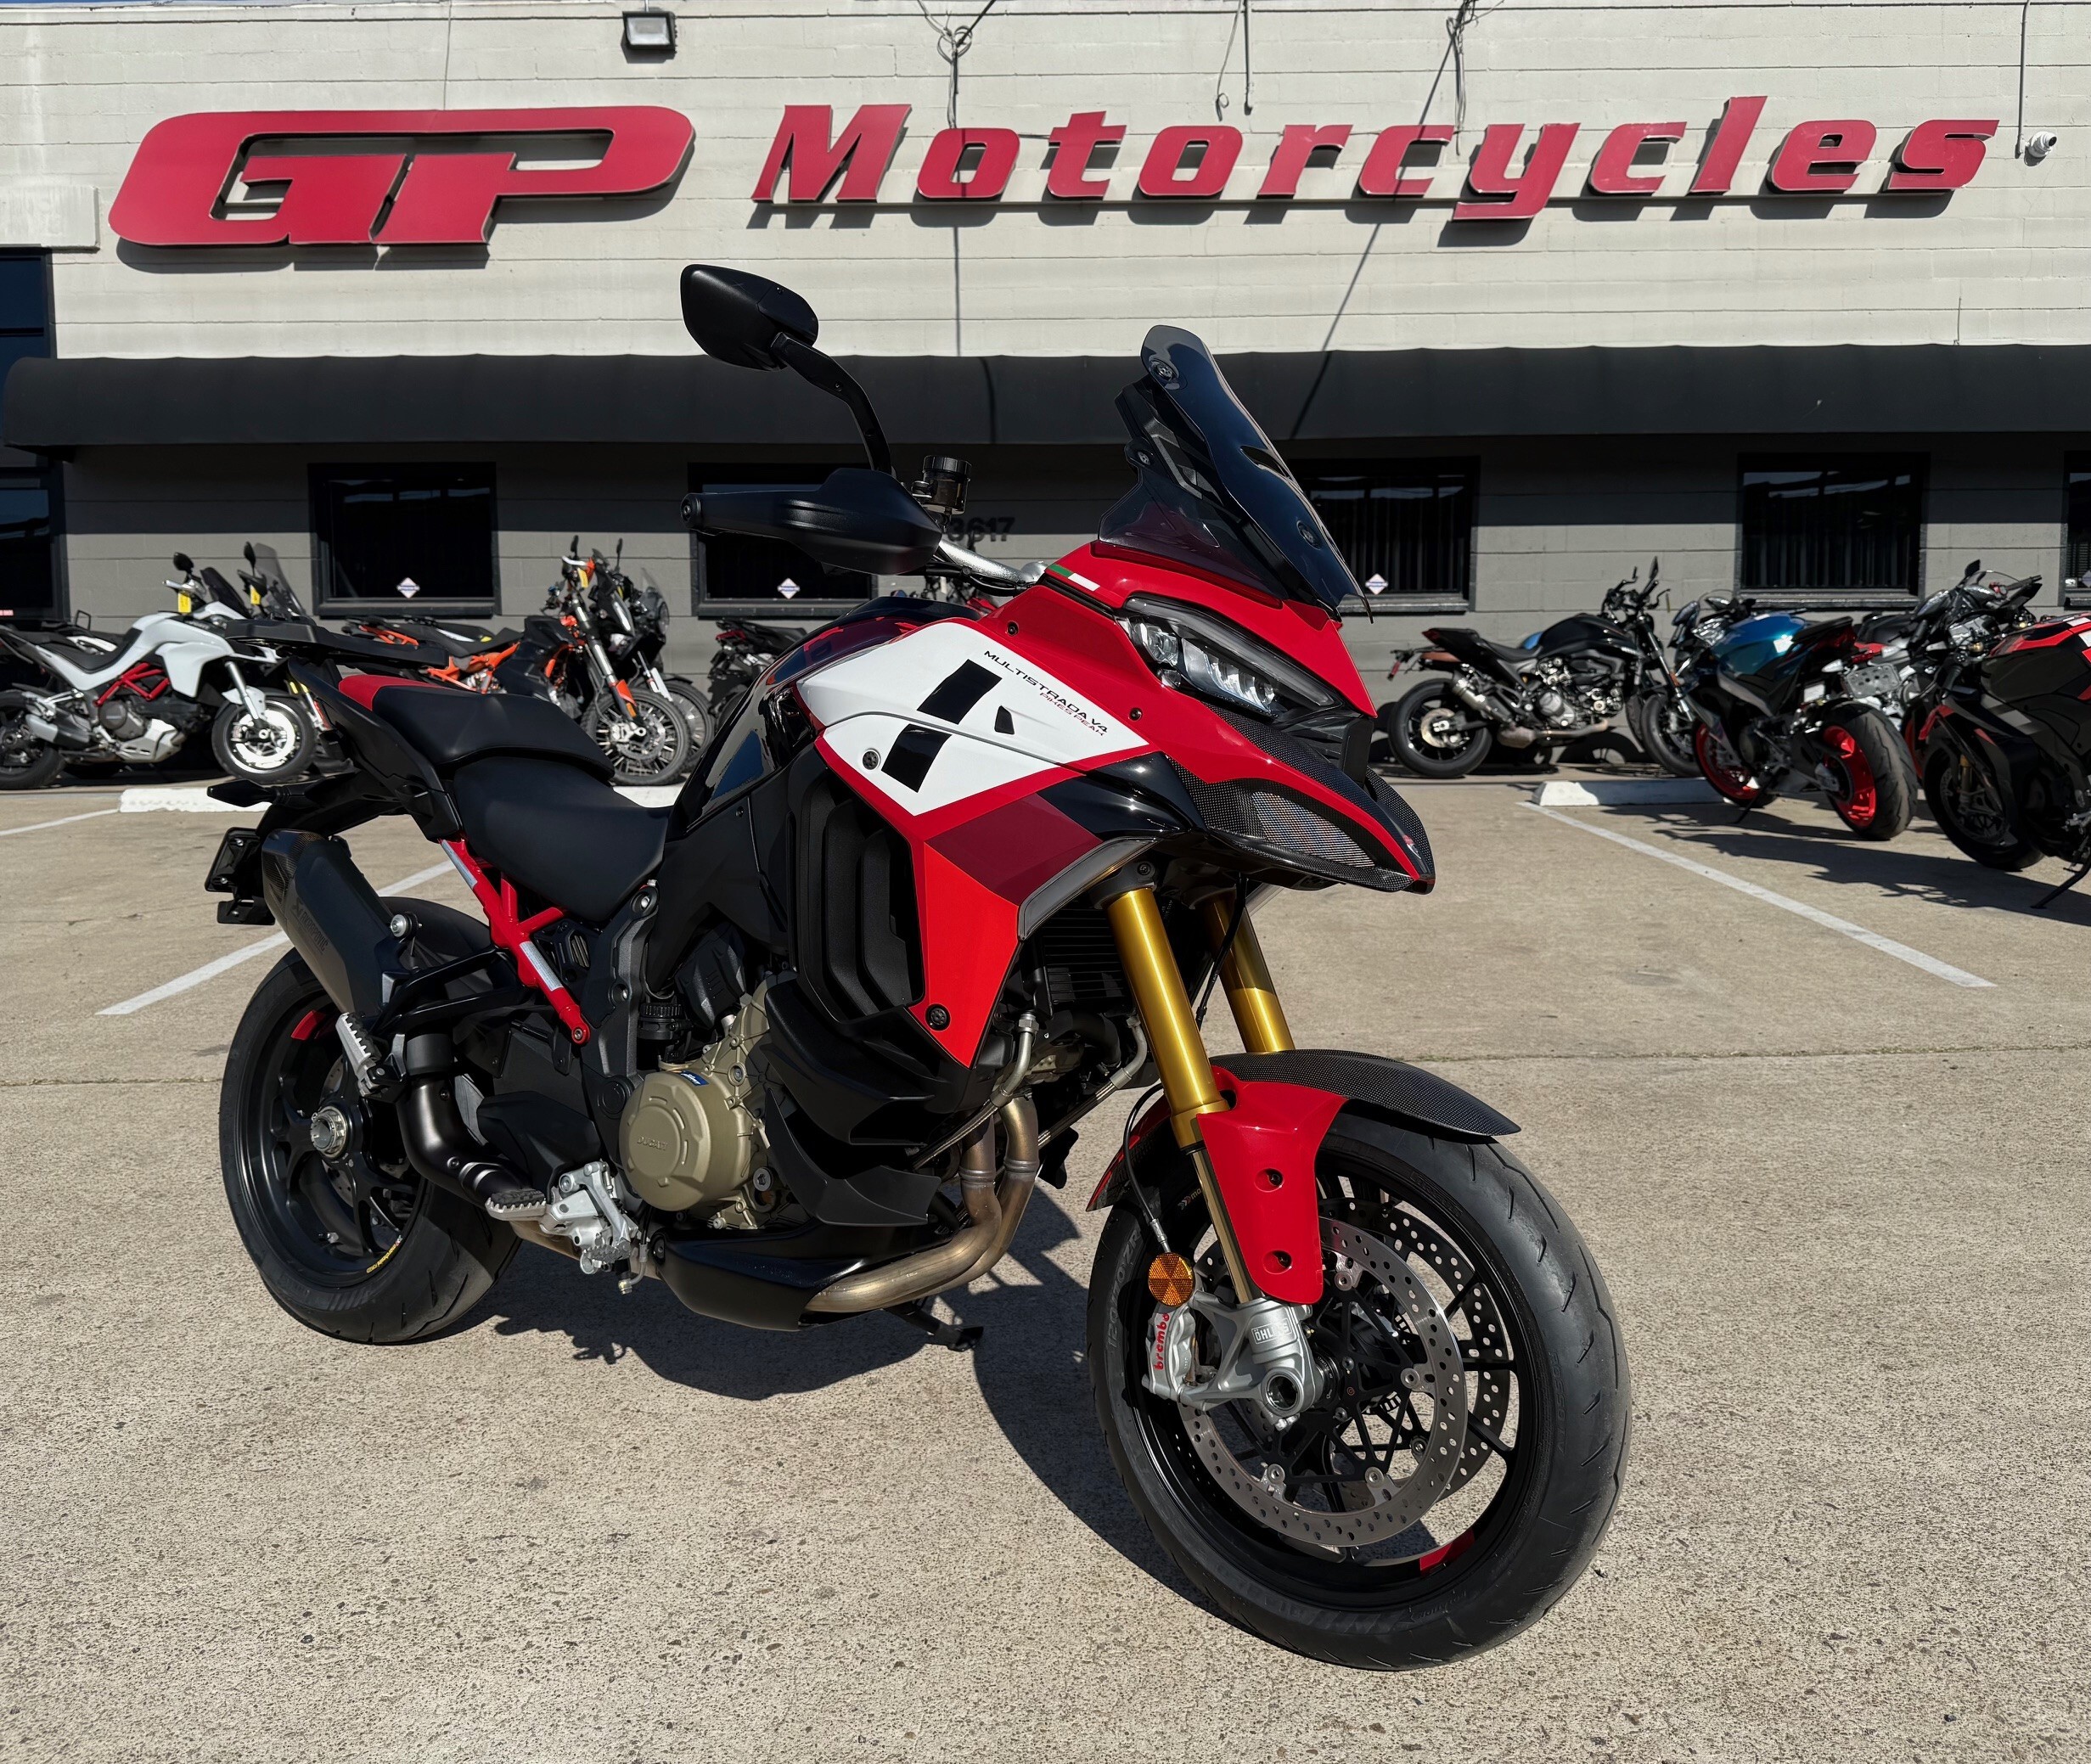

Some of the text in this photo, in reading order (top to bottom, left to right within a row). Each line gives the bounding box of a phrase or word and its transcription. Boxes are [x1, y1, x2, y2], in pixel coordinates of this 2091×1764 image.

[109, 96, 1999, 245] GP Motorcycles
[984, 650, 1108, 733] MULTISTRADA V4
[1039, 692, 1105, 736] PIKES PEAK
[1153, 1312, 1170, 1370] brembo
